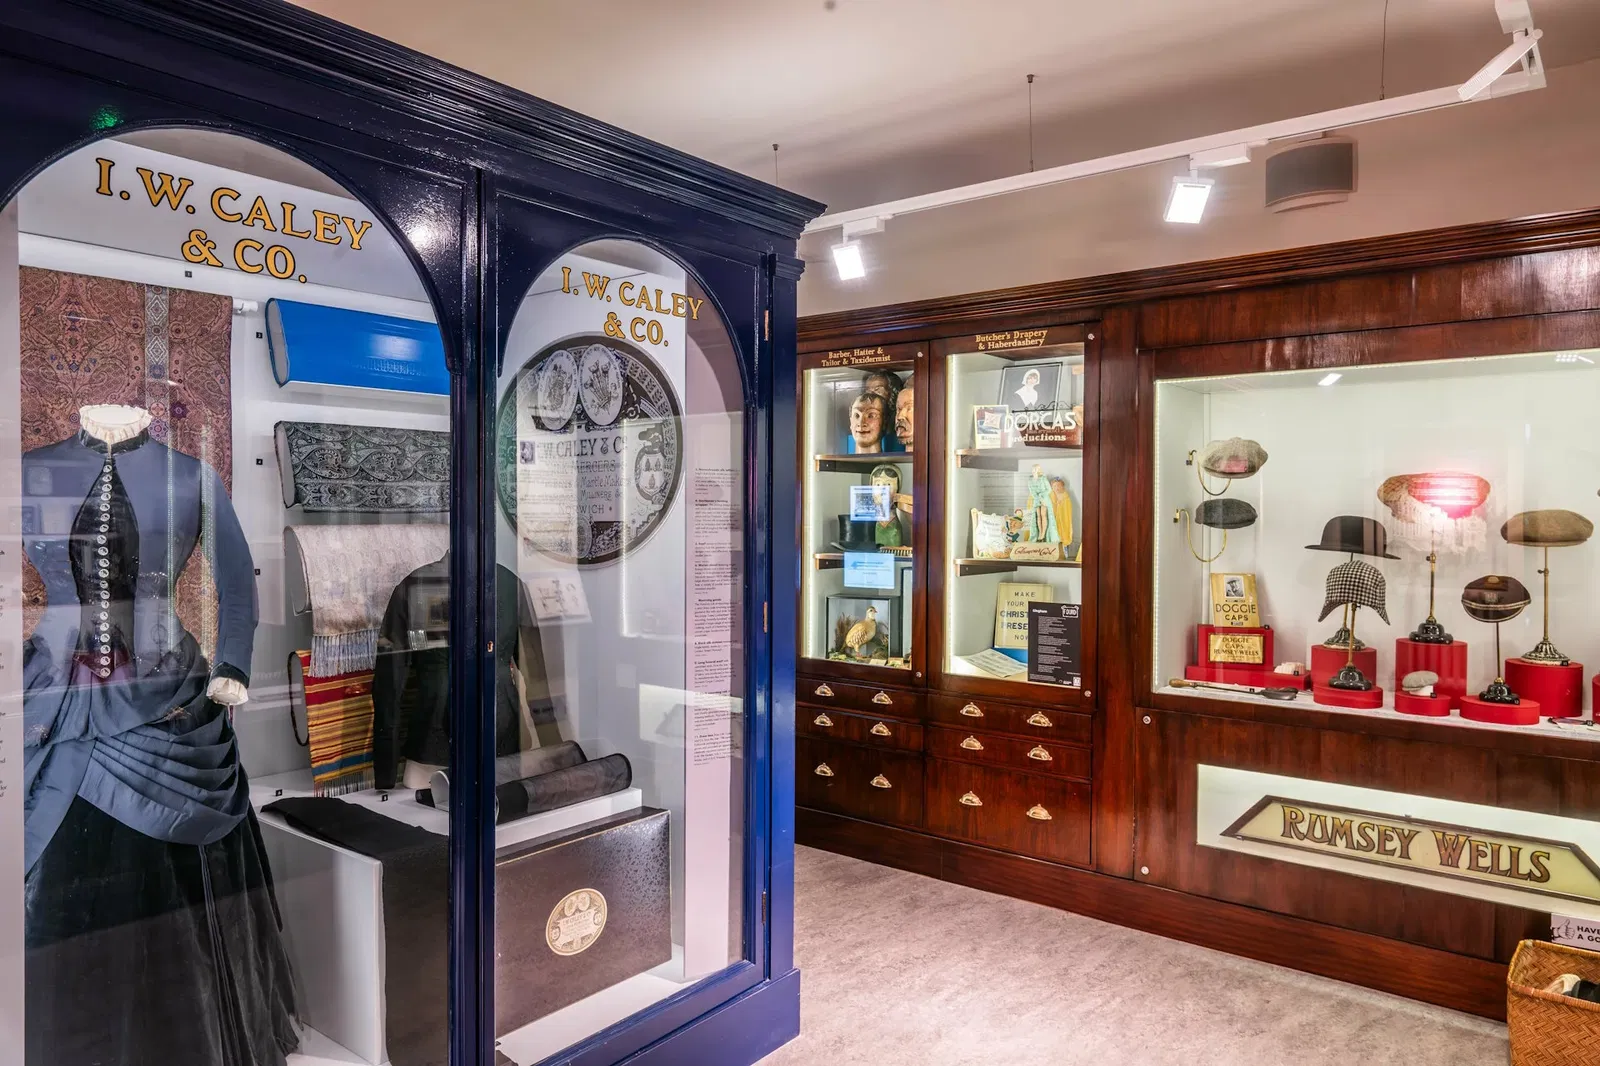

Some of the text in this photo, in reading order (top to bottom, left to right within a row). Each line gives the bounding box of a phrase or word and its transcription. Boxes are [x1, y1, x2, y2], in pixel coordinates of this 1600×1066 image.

[210, 186, 373, 251] CALEY
[181, 229, 308, 284] & CO.
[618, 281, 704, 320] CALEY
[603, 312, 669, 347] & CO.
[975, 330, 1048, 343] Butcher's Drapery
[828, 346, 884, 359] Barber, Hatter &
[978, 338, 1045, 350] & Haberdashery
[821, 359, 841, 367] Tailor
[850, 354, 891, 365] Taxidermist
[1004, 411, 1076, 433] DORCAS
[556, 438, 597, 458] CALEY
[1215, 603, 1256, 614] DOGGIE
[1222, 636, 1249, 644] DOGGIE
[1280, 805, 1550, 884] RUMSEY WELLS
